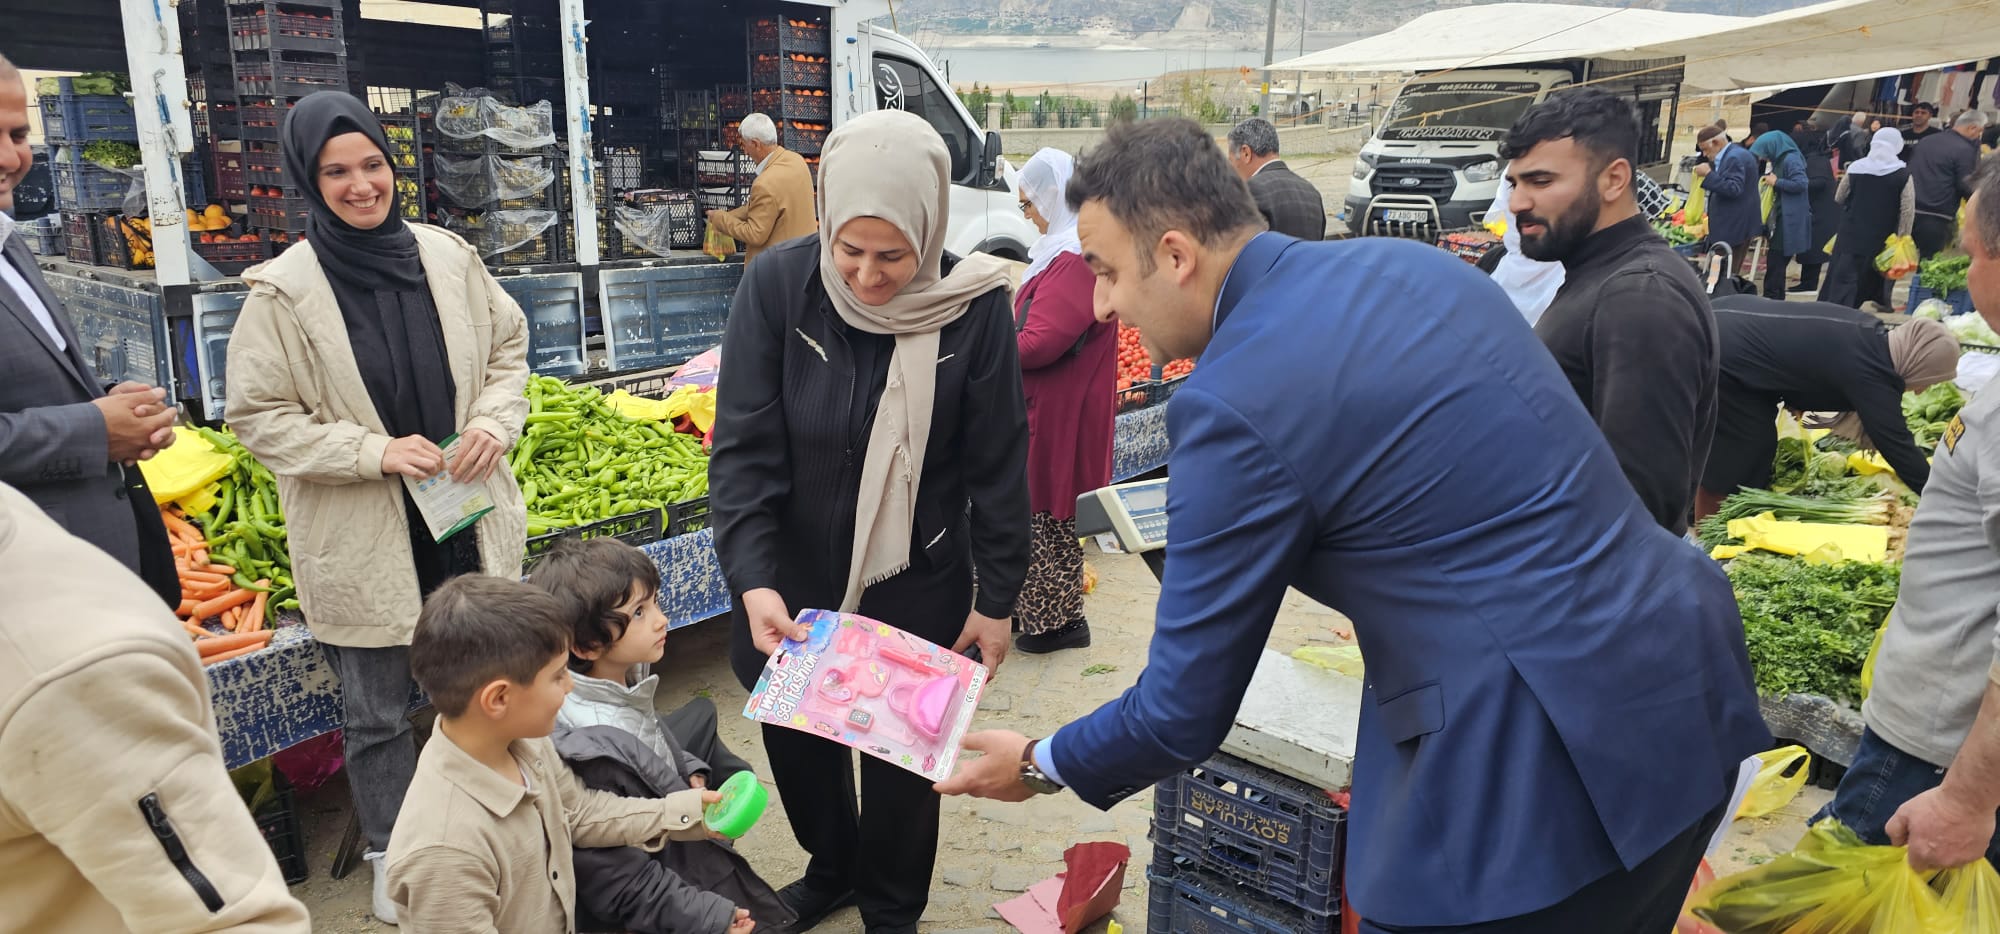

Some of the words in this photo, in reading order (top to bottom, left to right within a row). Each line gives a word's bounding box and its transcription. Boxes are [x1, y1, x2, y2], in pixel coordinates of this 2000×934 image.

[761, 669, 788, 711] maxi
[775, 695, 797, 721] set
[1191, 799, 1289, 845] SOYLULAR
